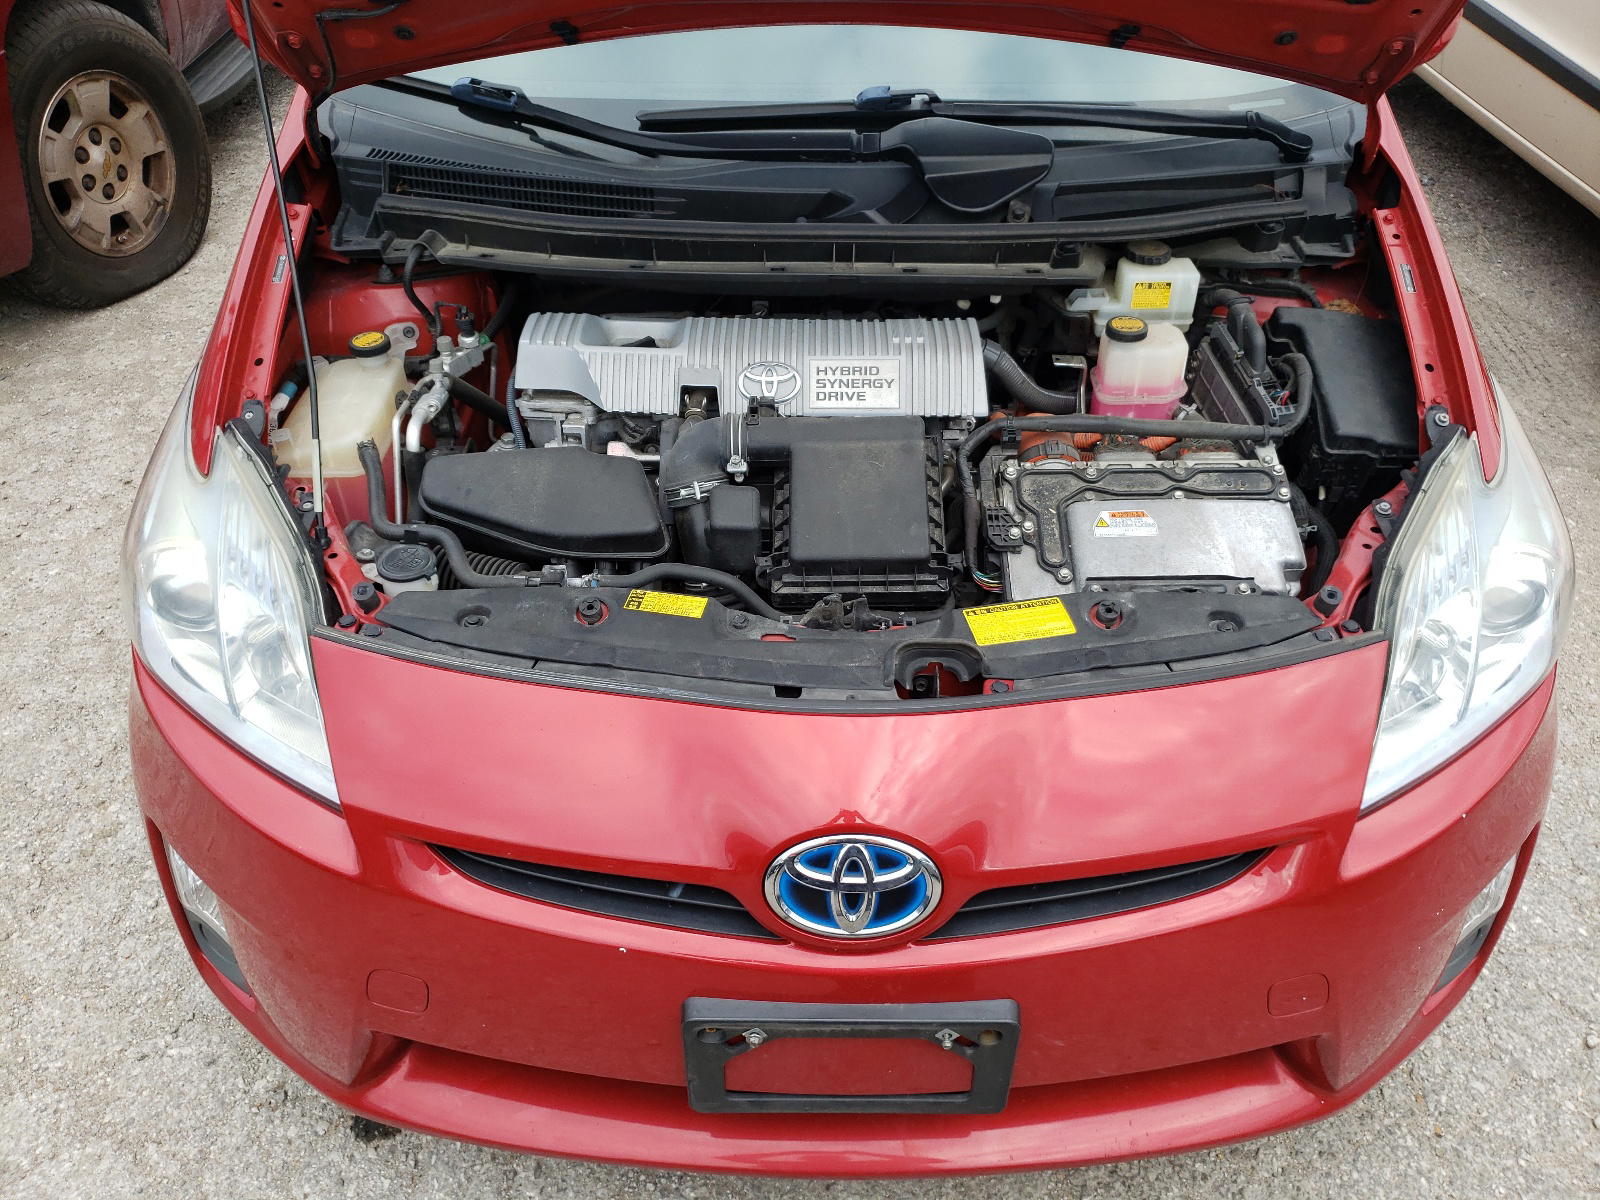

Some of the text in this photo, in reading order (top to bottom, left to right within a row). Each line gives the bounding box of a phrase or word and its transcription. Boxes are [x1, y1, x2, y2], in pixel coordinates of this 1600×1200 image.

[816, 366, 880, 376] HYBRID
[815, 378, 895, 389] SYNERGY
[816, 391, 867, 401] DRIVE
[989, 604, 1018, 613] CAUTION
[1020, 598, 1058, 609] ATTENTION
